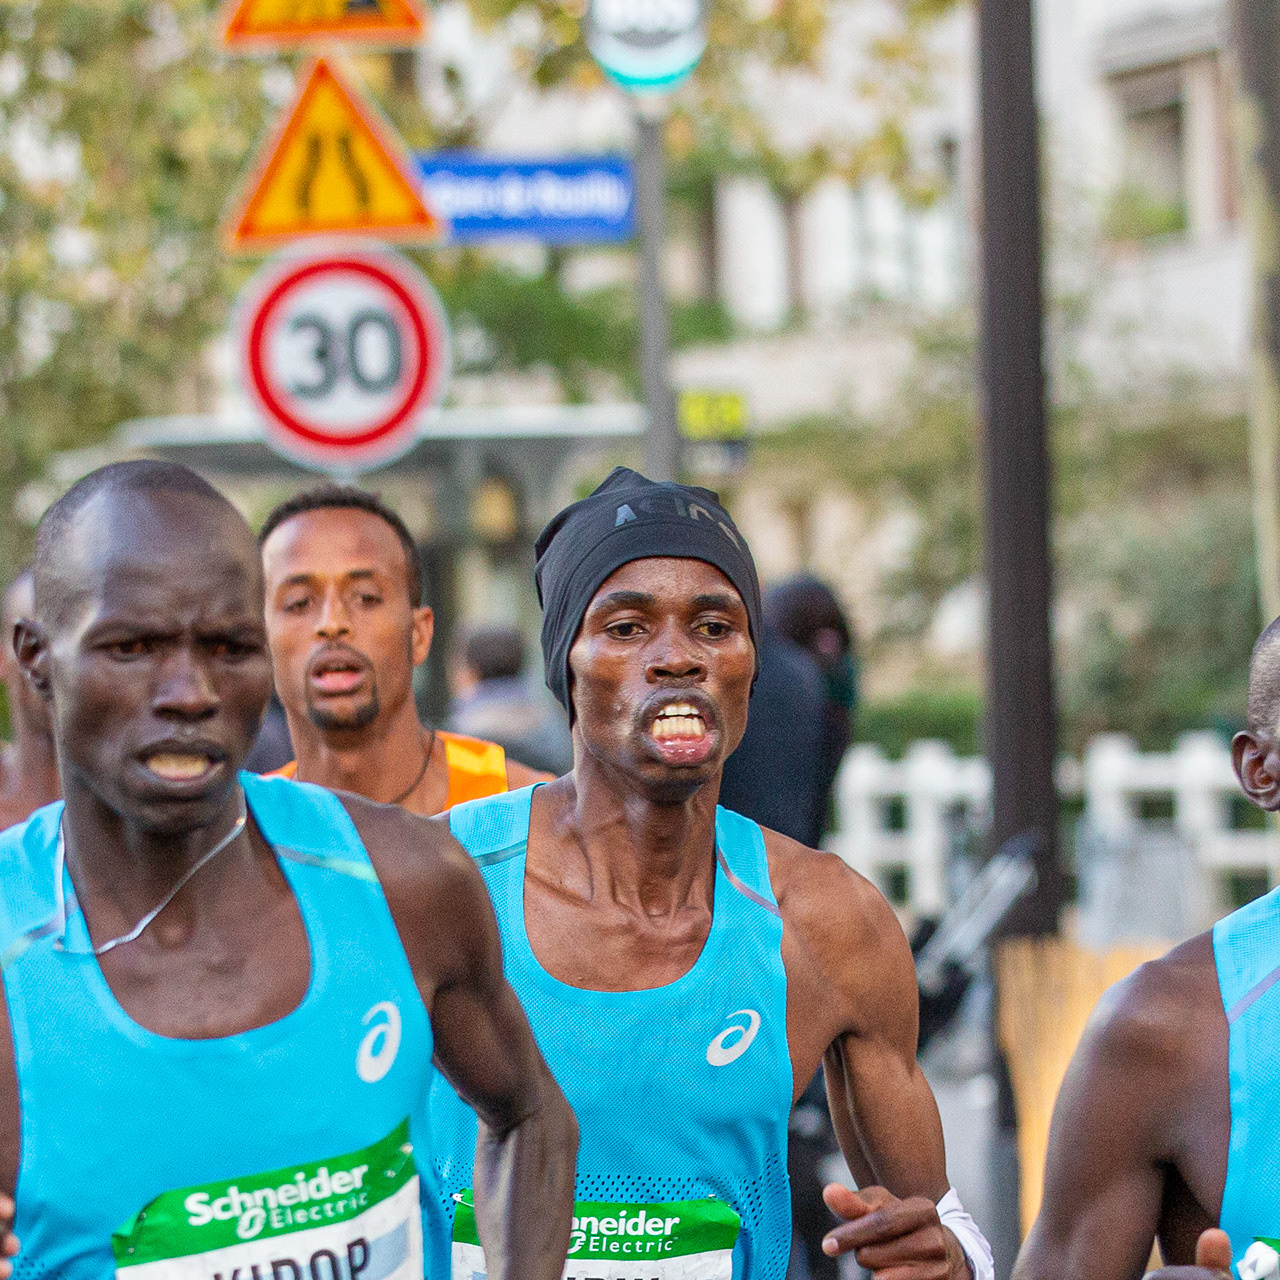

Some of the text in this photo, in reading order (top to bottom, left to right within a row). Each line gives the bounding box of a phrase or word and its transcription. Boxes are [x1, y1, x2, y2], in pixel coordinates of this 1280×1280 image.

[287, 307, 403, 399] 30
[184, 1164, 369, 1227] Schneider
[270, 1190, 369, 1229] Electric
[571, 1209, 680, 1236] neider
[589, 1236, 673, 1253] Electric
